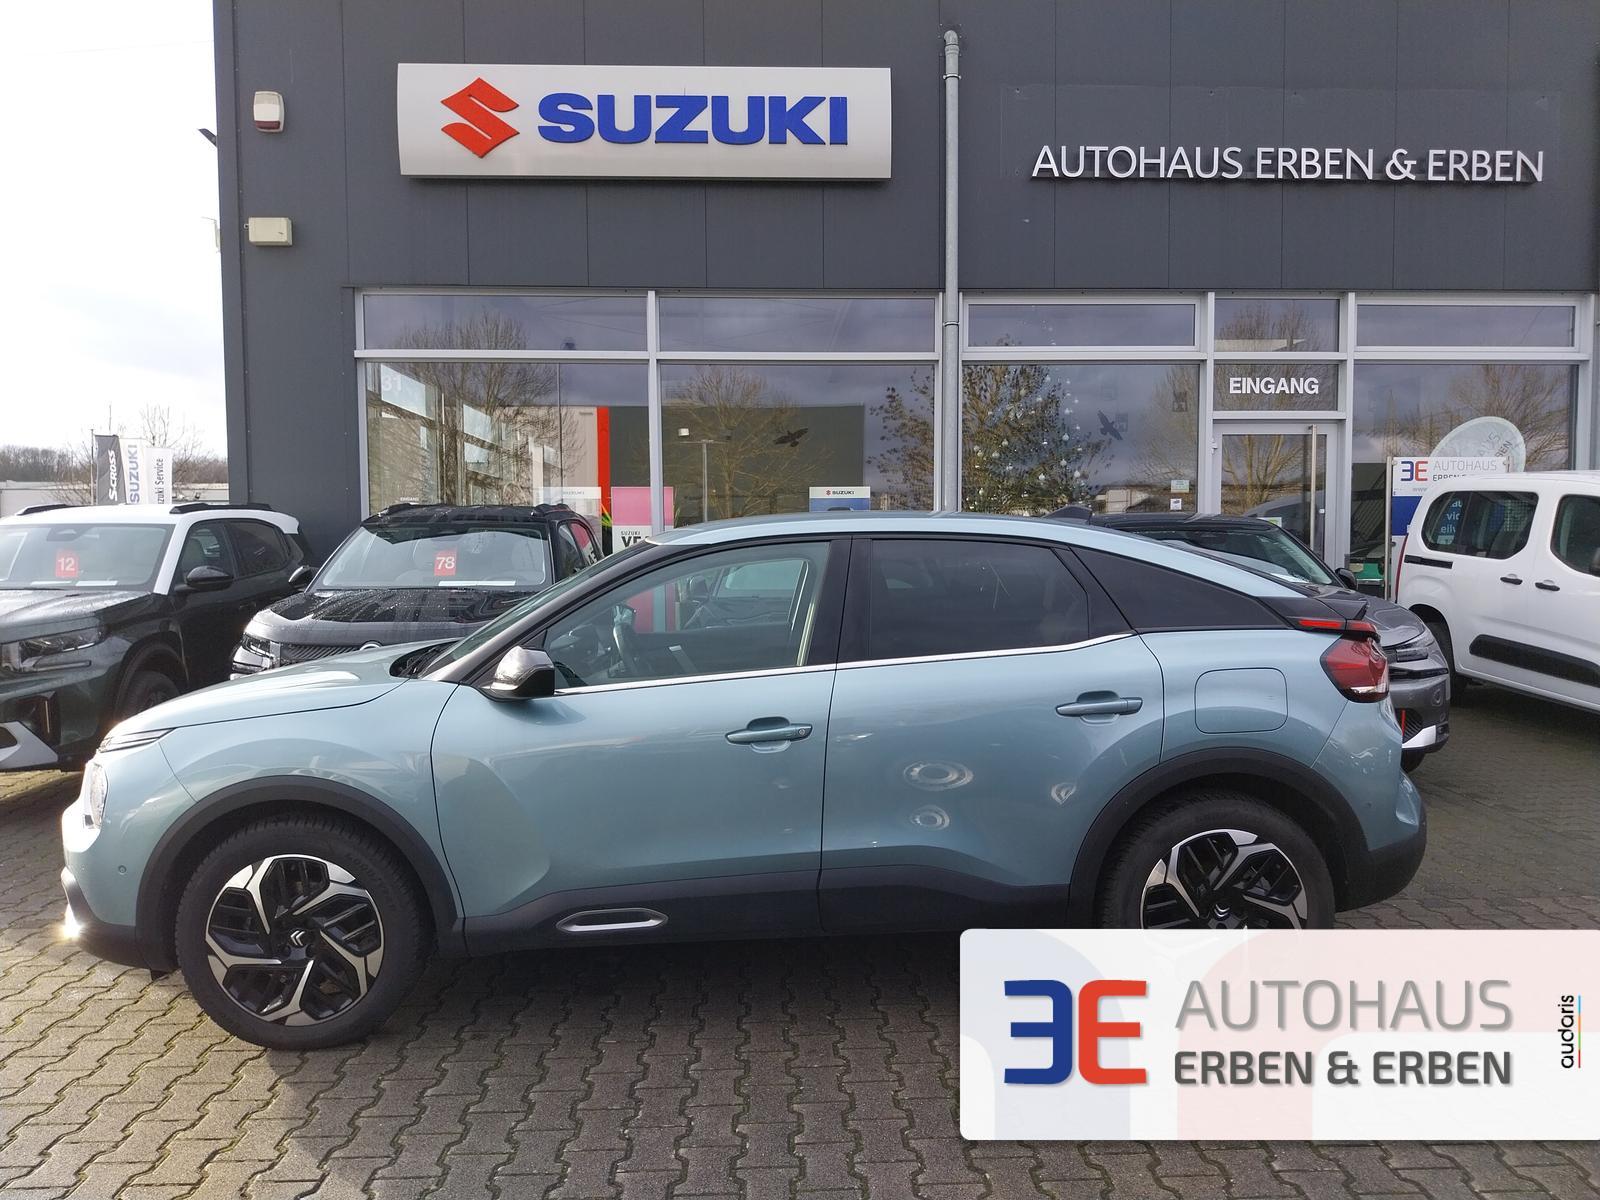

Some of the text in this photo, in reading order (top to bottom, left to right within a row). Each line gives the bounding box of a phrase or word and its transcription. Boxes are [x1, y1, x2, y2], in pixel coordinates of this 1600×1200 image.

[538, 93, 848, 145] SUZUKI
[1032, 145, 1545, 182] AUTOHAUS ERBEN & ERBEN
[1229, 377, 1319, 394] EINGANG
[127, 444, 140, 504] SUZUKI
[154, 458, 164, 486] Service
[1433, 460, 1497, 471] AUTOHAUS
[57, 557, 76, 571] 12
[436, 556, 455, 569] 78
